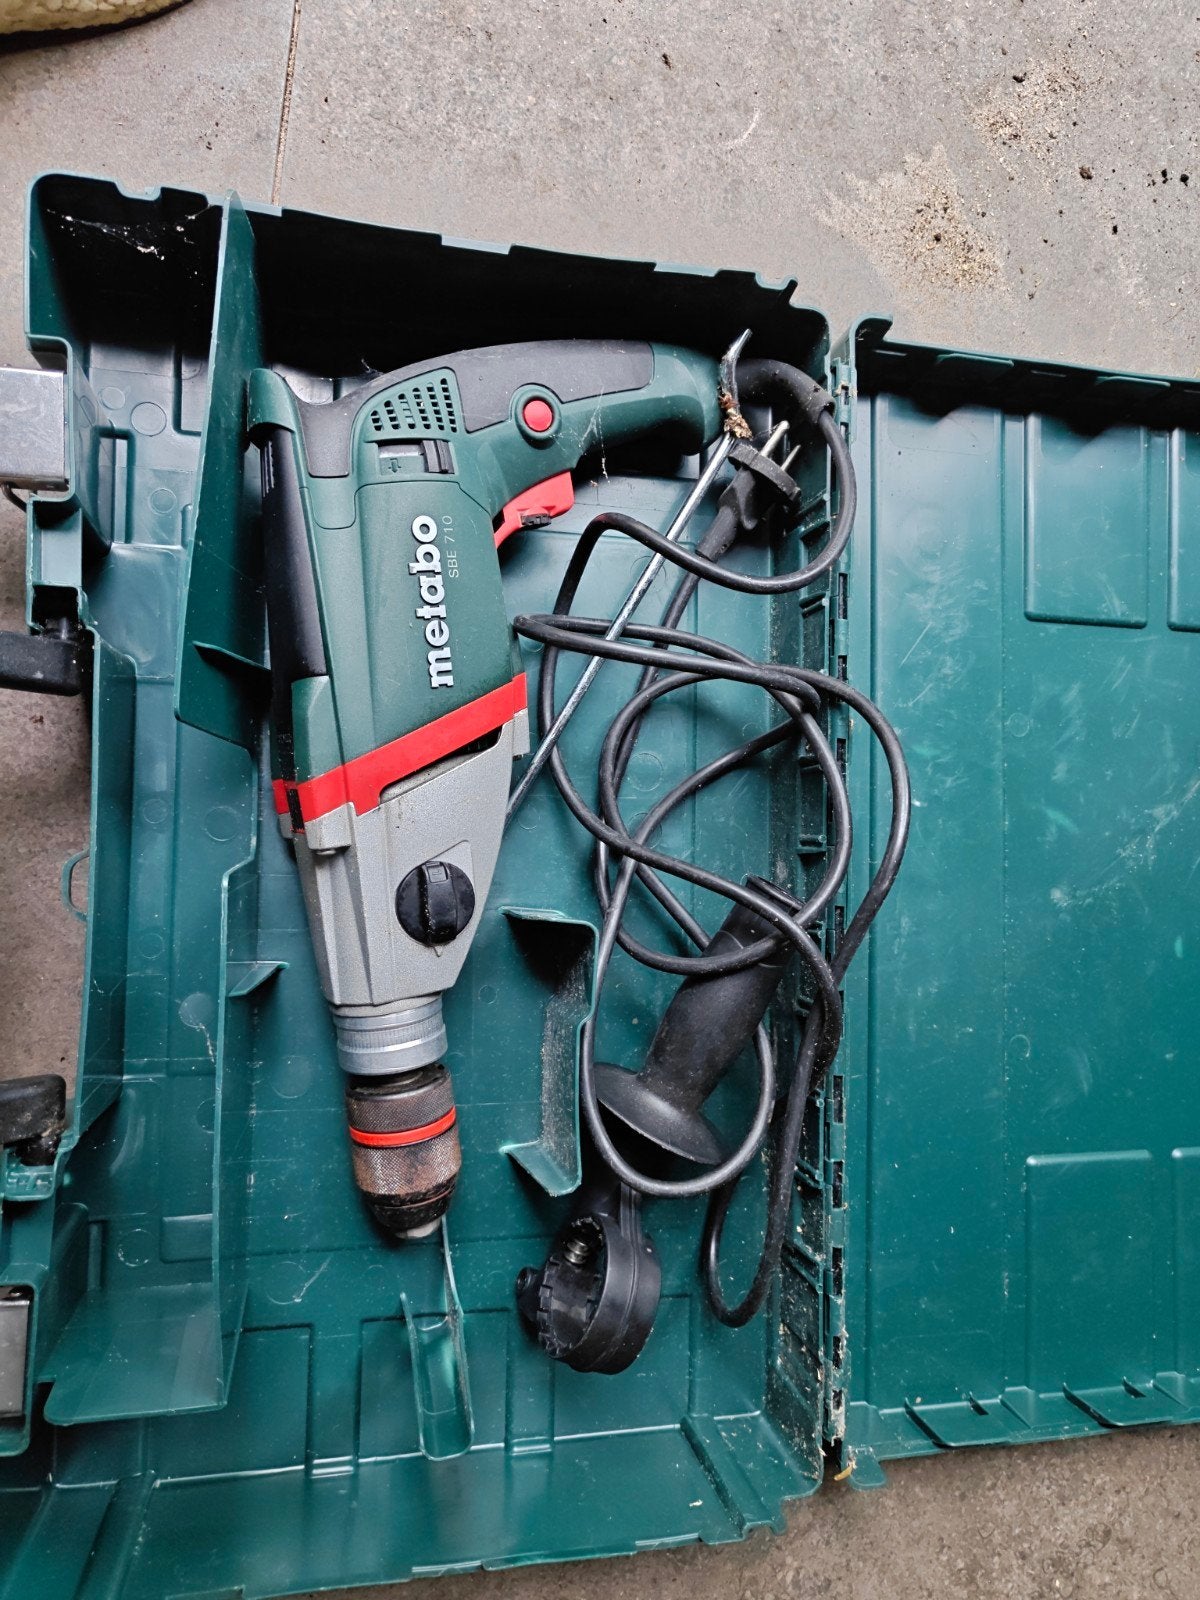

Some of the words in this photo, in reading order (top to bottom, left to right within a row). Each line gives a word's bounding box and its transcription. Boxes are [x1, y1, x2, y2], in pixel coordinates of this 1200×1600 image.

[442, 515, 455, 543] 710
[448, 550, 459, 578] SBE
[409, 515, 454, 688] metabo
